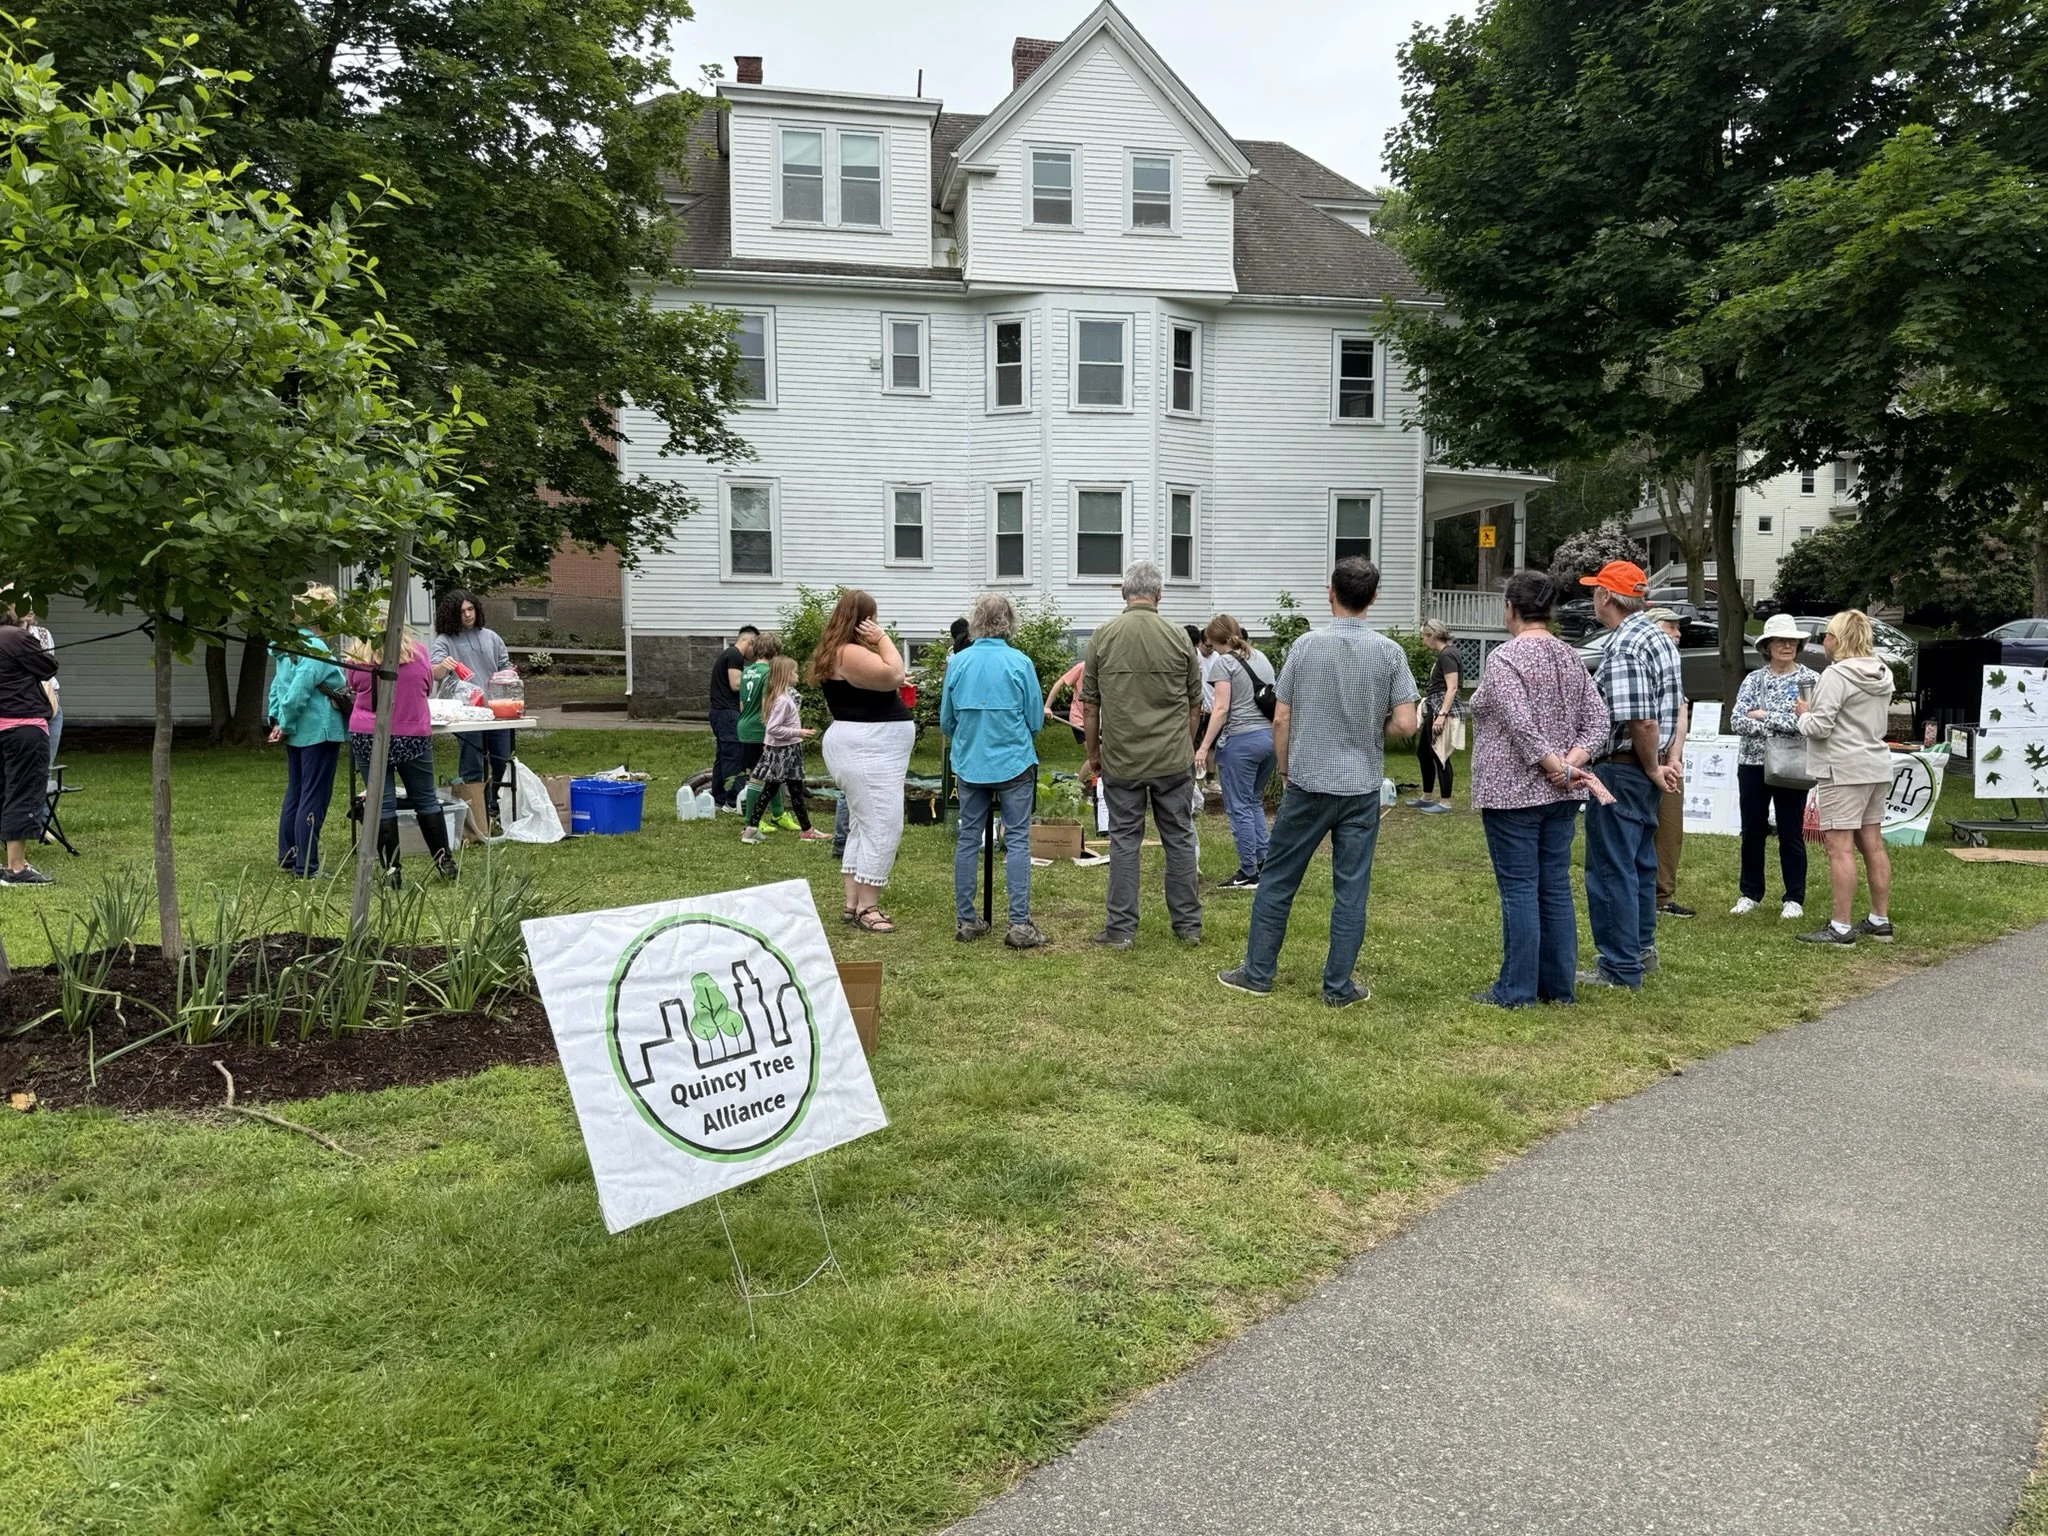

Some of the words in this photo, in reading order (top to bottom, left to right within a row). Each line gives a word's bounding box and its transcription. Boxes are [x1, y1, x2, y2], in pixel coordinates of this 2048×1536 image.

[1885, 801, 1907, 813] ree
[671, 1069, 746, 1107] Quincy
[749, 1055, 795, 1080] Tree
[704, 1093, 786, 1135] Alliance
